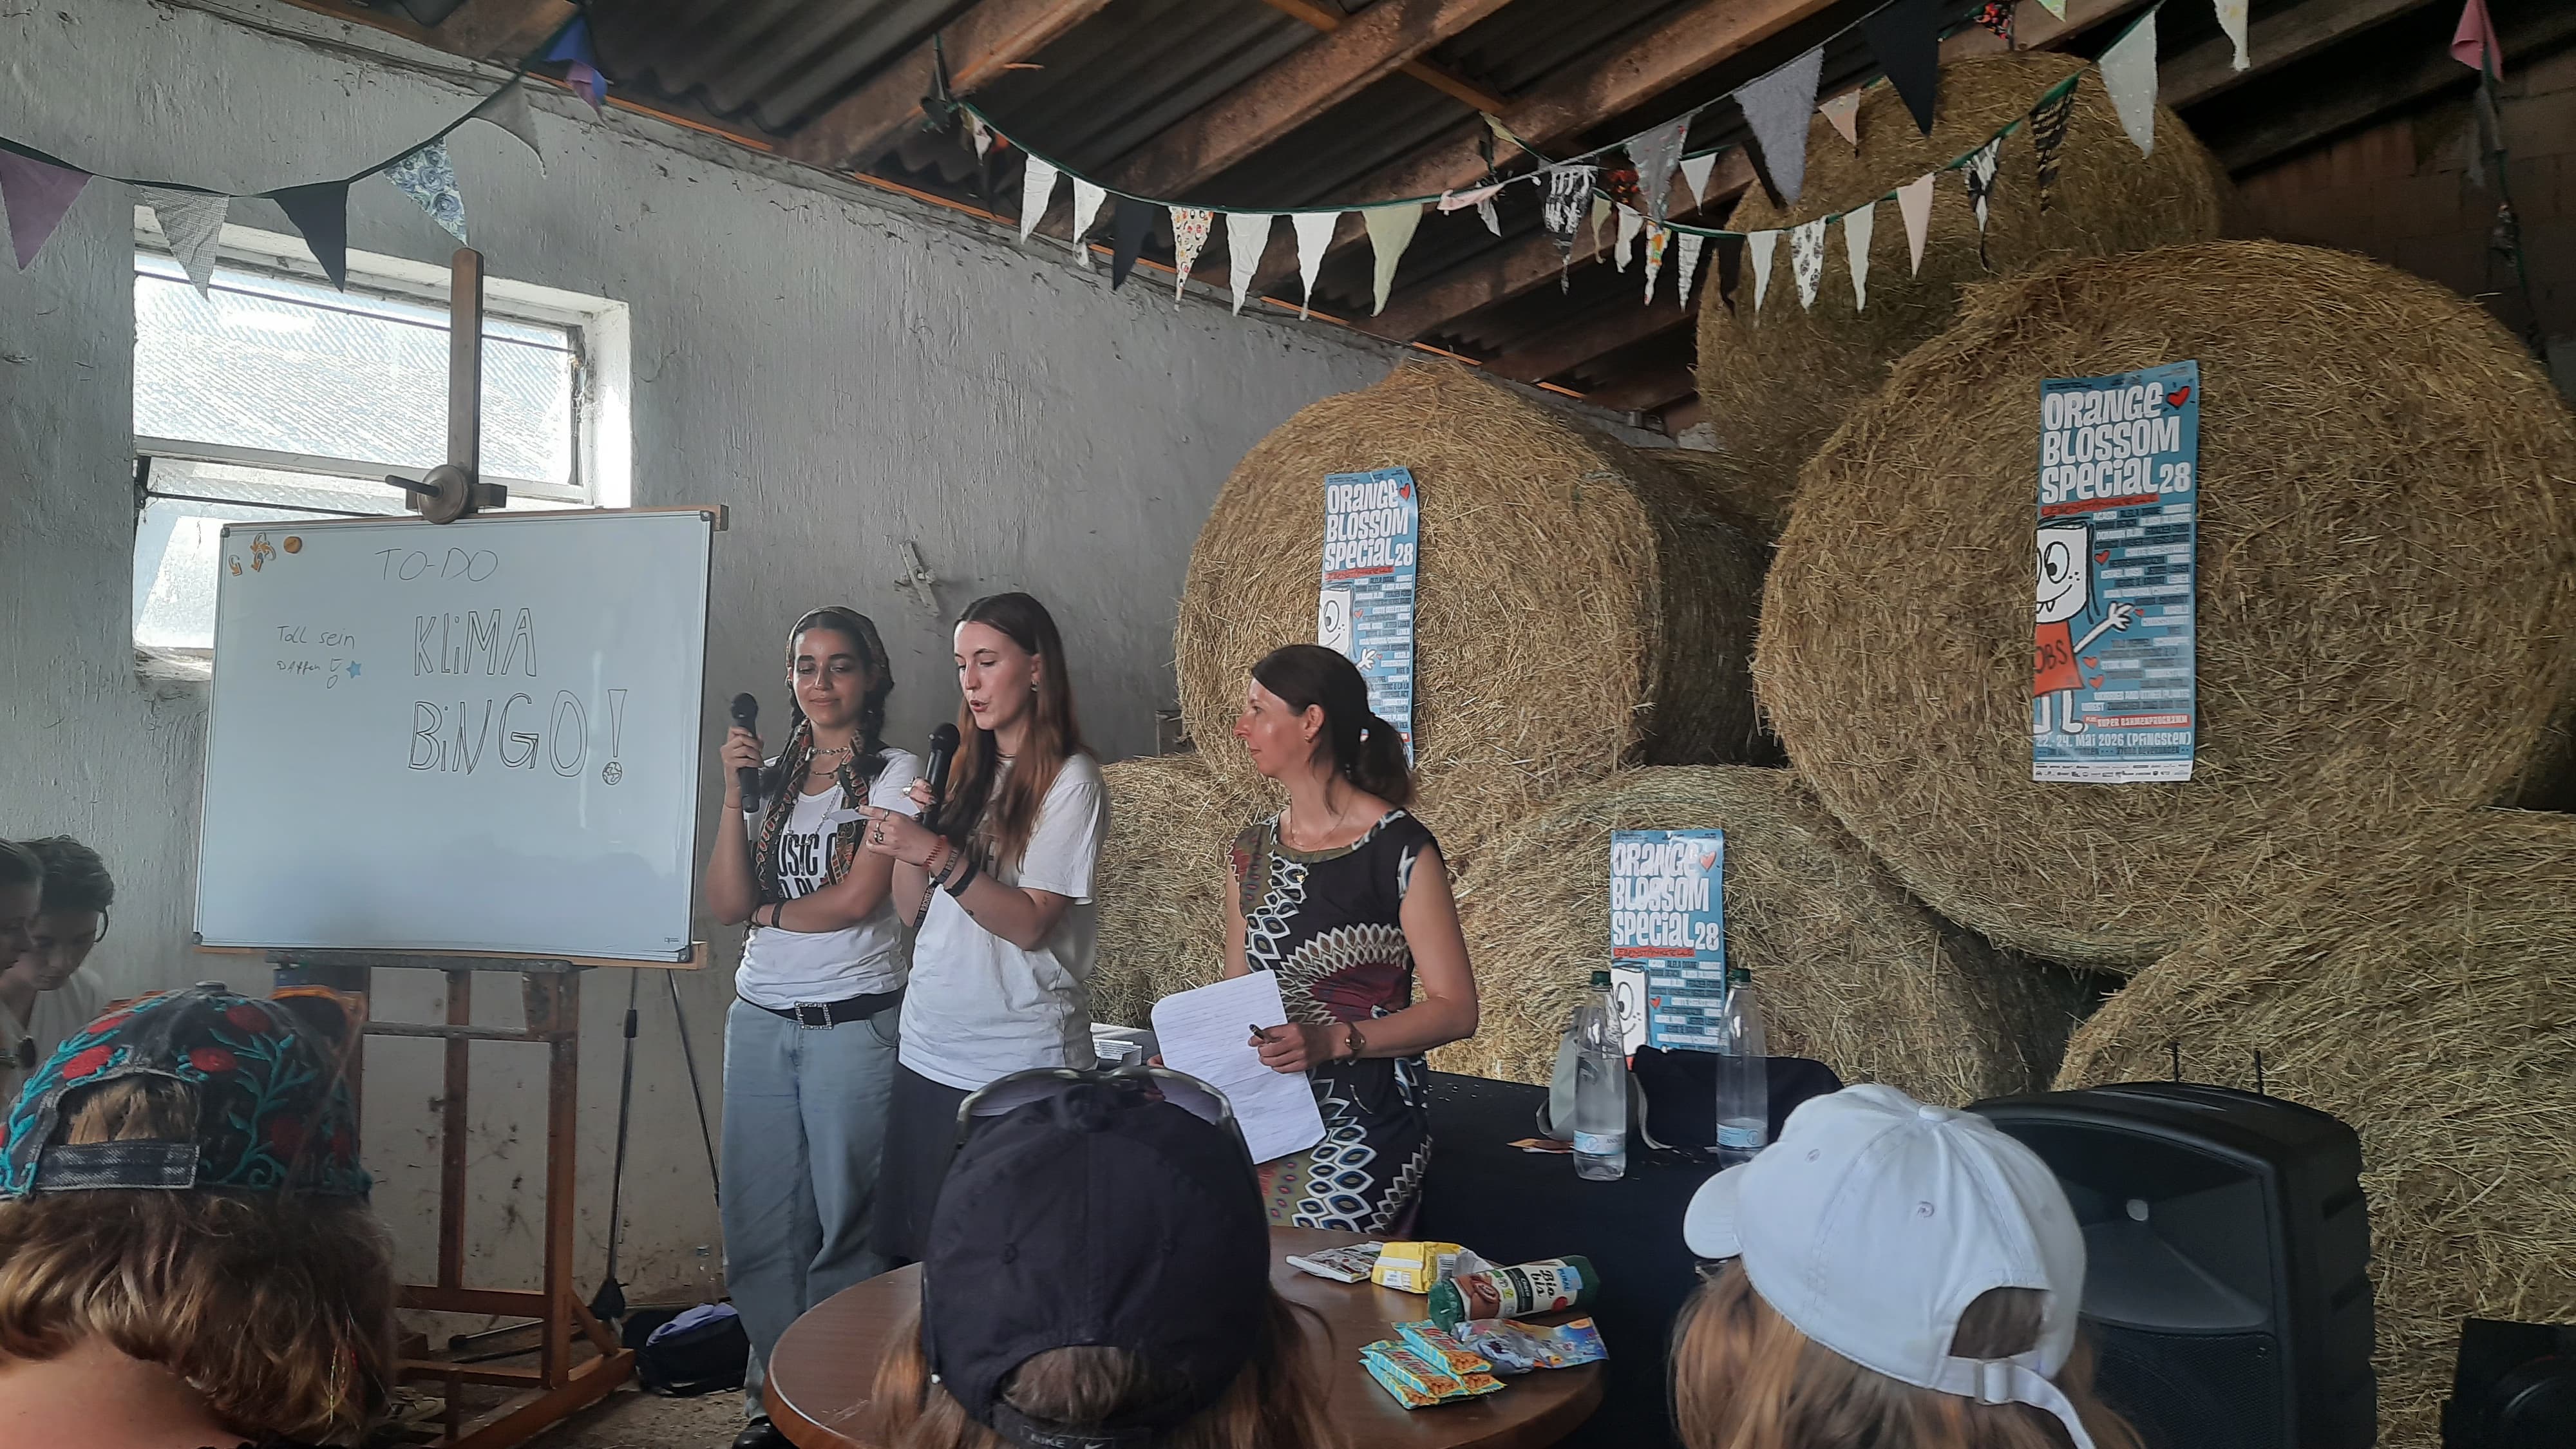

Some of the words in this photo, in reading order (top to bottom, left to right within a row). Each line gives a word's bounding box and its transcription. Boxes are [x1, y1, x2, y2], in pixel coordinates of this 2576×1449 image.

[2043, 415, 2181, 467] BLOSSOM
[2159, 462, 2192, 495] 28
[1326, 507, 1409, 543] BLOSSOM
[374, 547, 498, 582] TO-DO
[1394, 542, 1414, 567] 28
[318, 628, 355, 650] sein
[2076, 733, 2096, 748] Mai
[2098, 733, 2125, 747] 2026
[778, 833, 820, 877] USIC
[1612, 876, 1710, 913] BLOSSOM
[1694, 922, 1719, 951] 28
